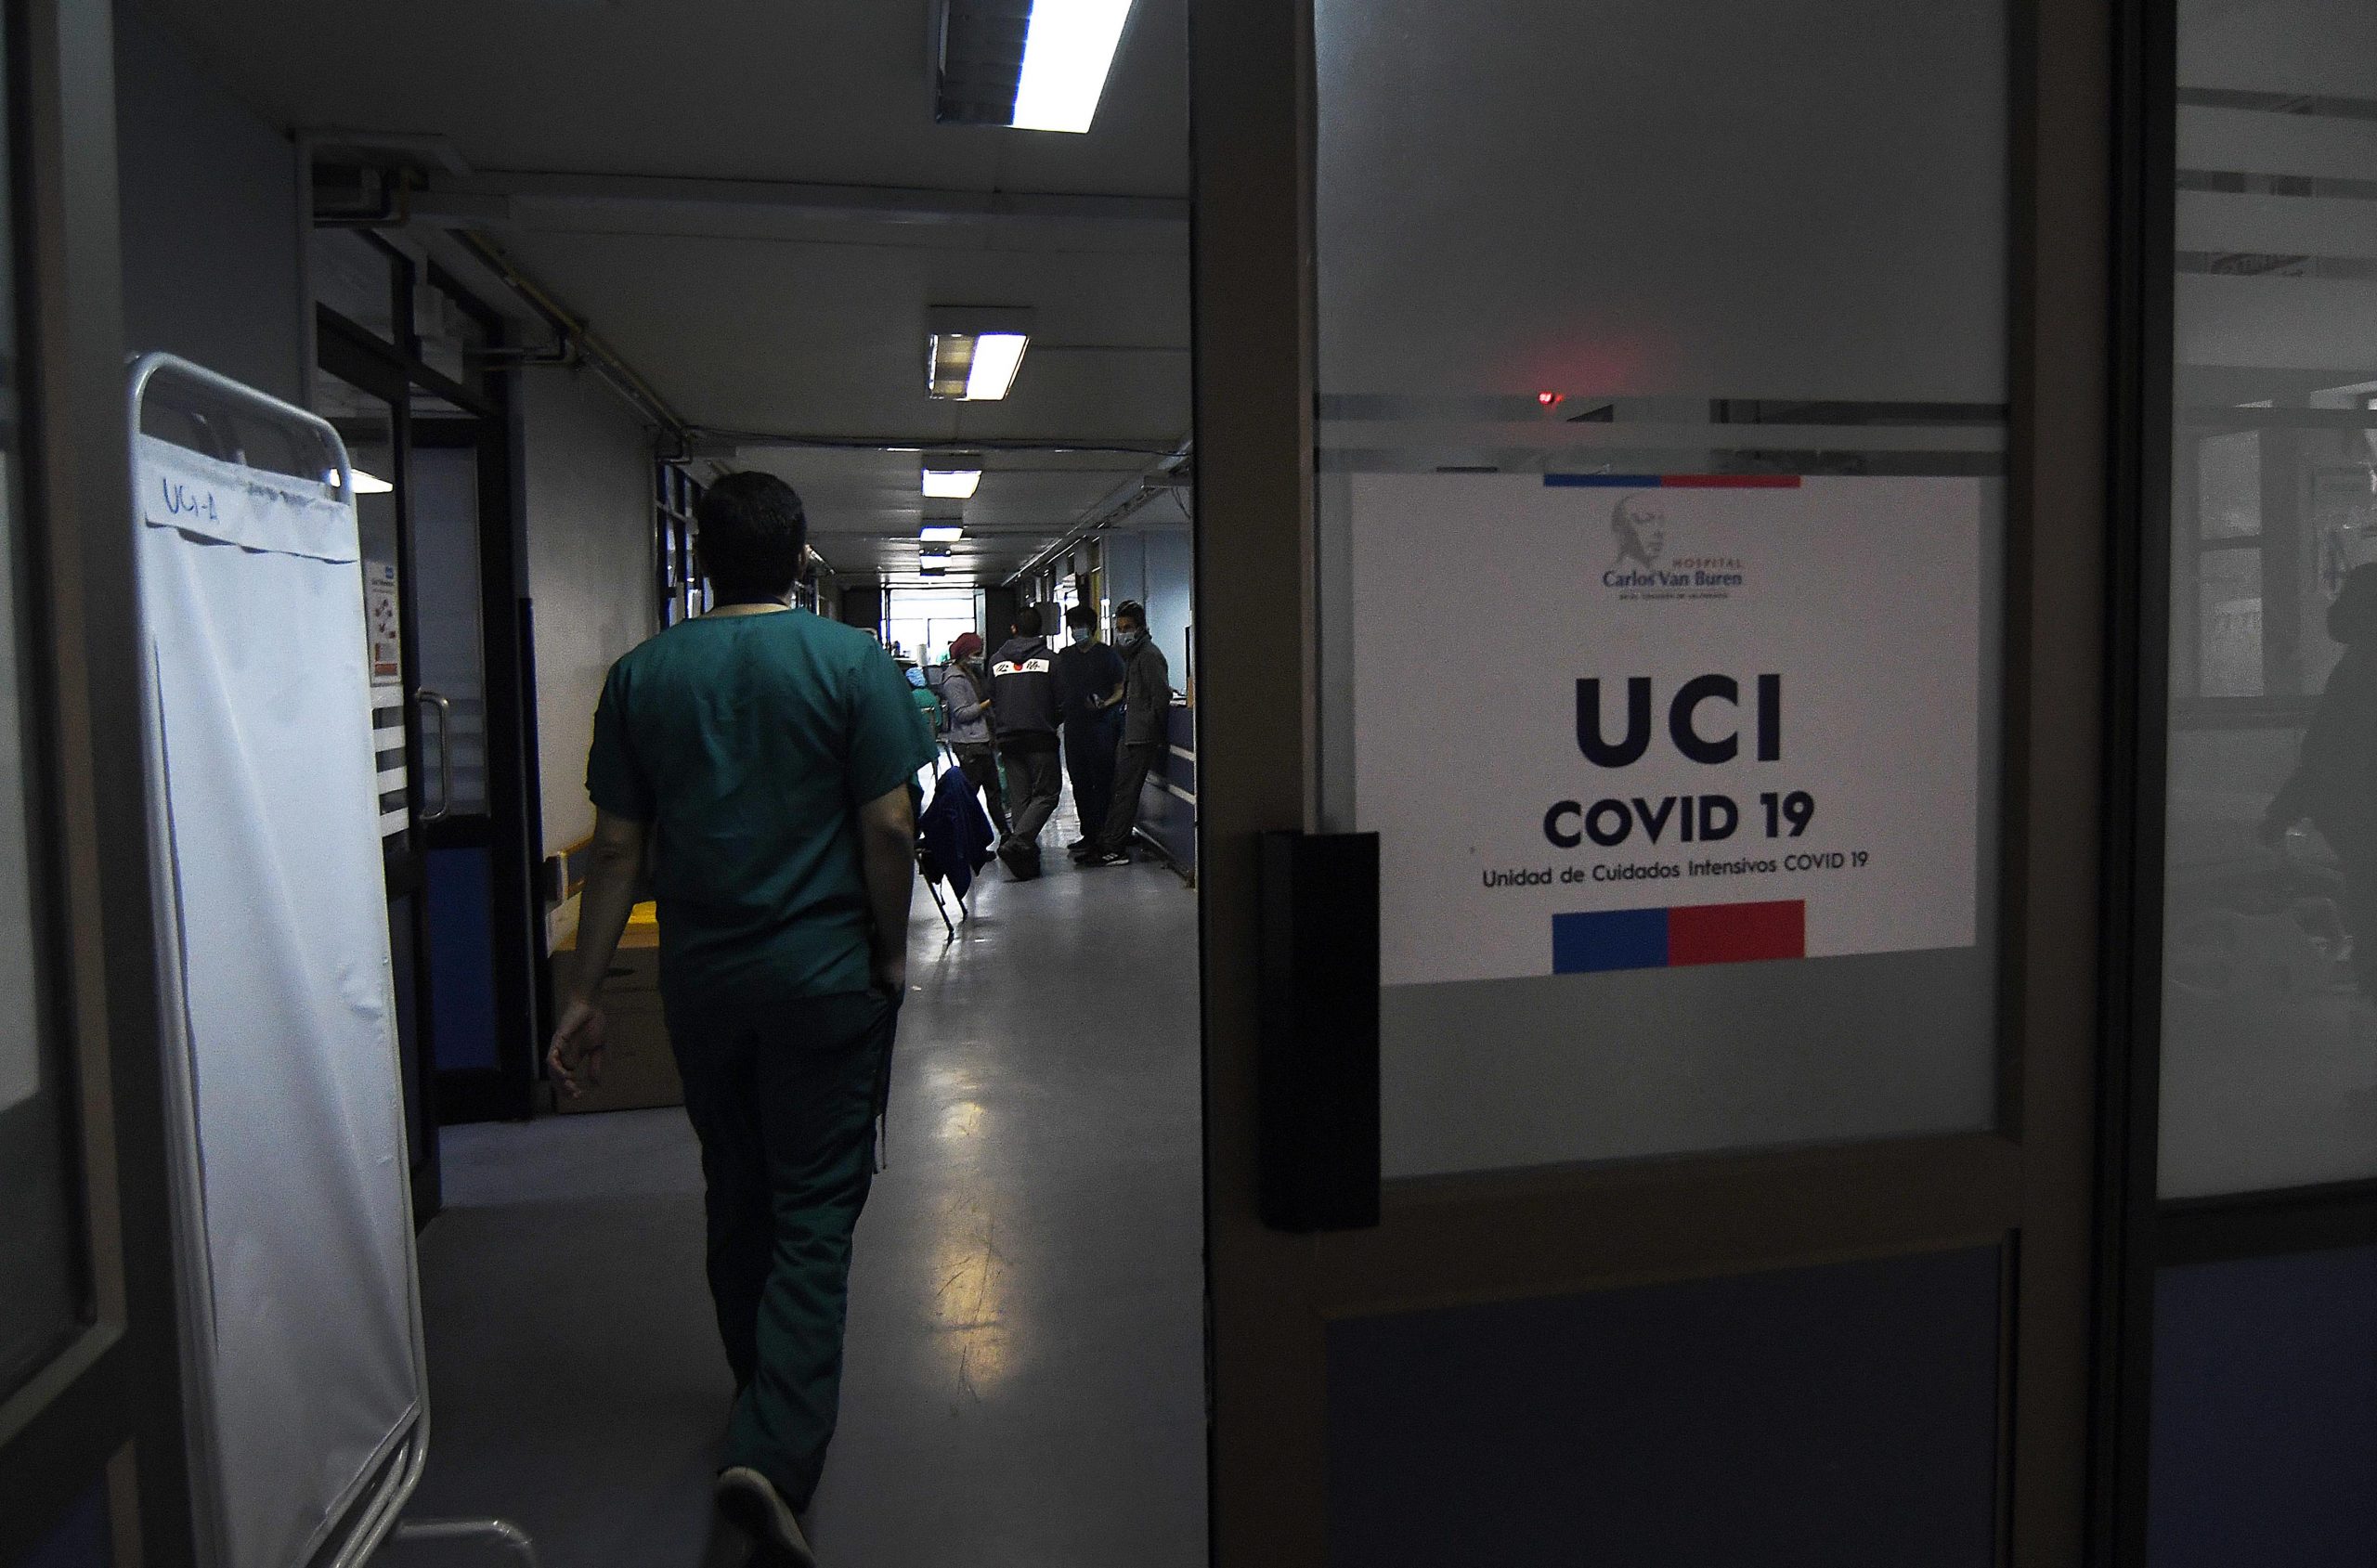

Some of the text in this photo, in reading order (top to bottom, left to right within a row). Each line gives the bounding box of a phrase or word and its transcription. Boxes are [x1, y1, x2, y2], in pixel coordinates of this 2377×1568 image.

[1603, 570, 1743, 588] Carlos Van Buren
[1673, 557, 1743, 568] HOSPITAL
[1576, 673, 1781, 769] UCI
[1543, 790, 1814, 849] COVID 19
[1482, 850, 1869, 888] Unidad de Cuidados Intensivos COVID 19
